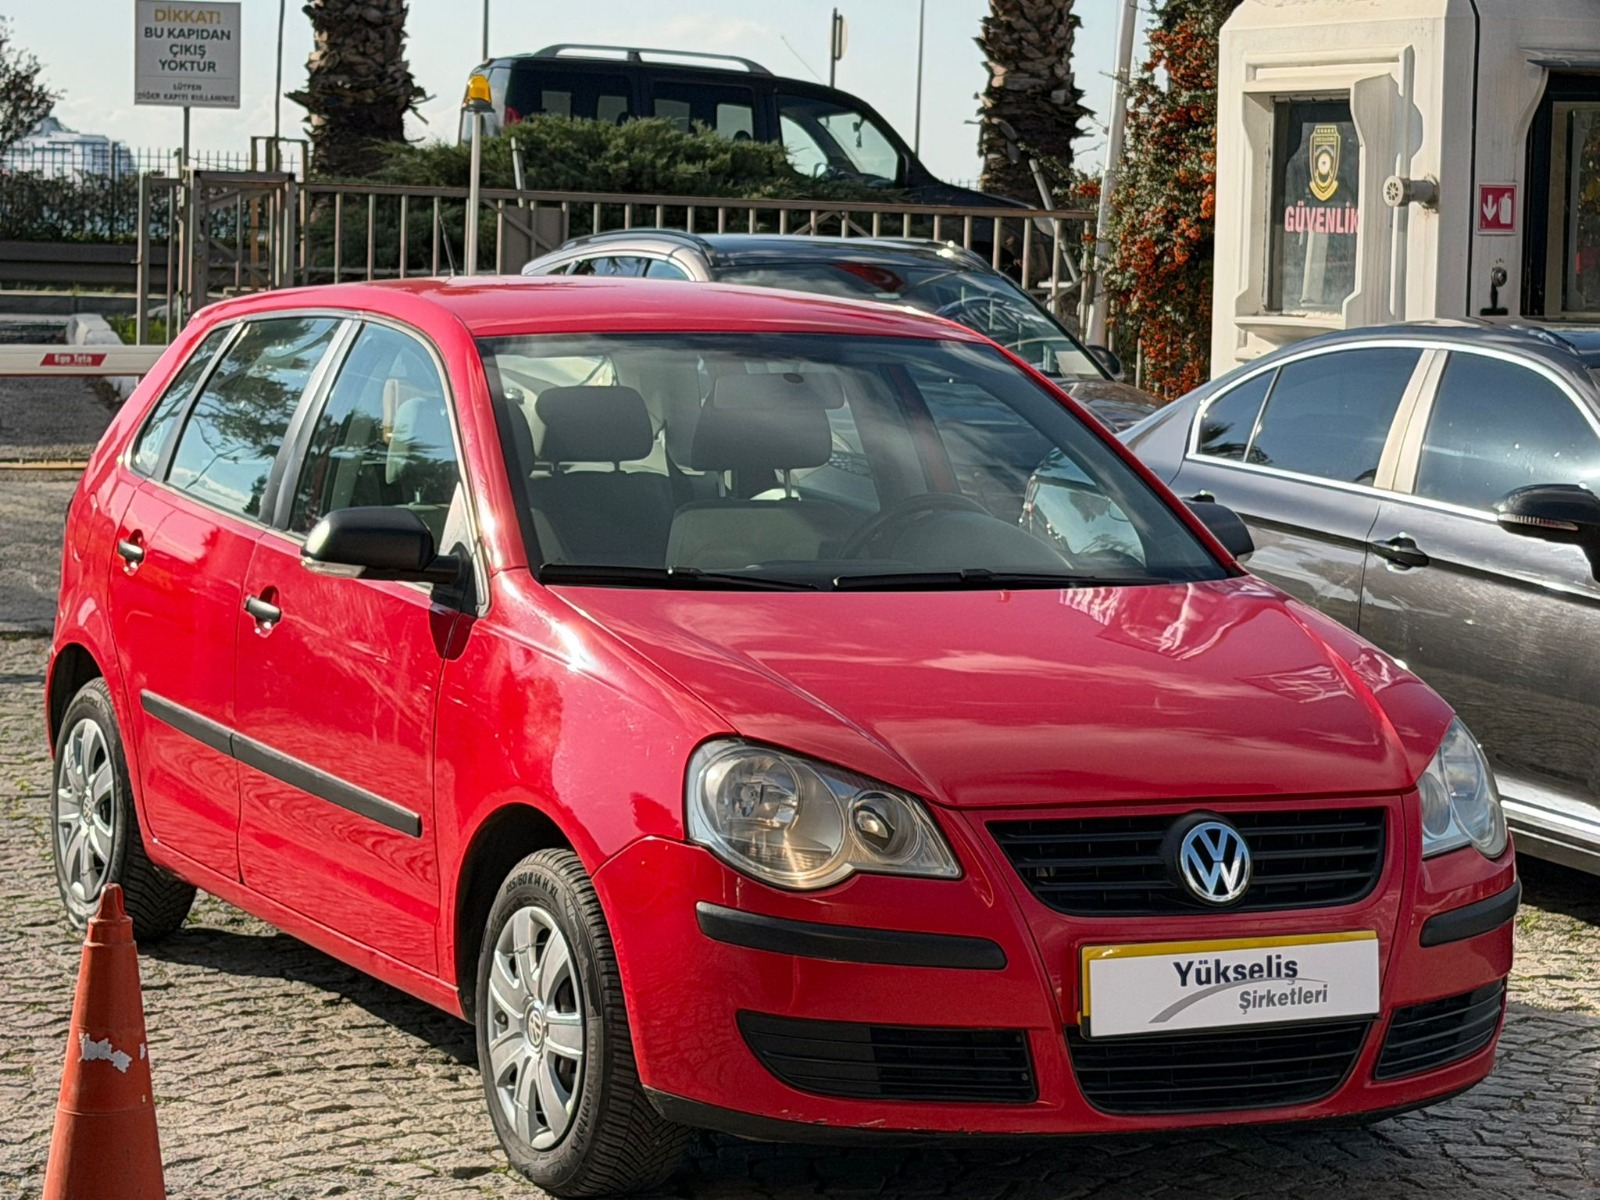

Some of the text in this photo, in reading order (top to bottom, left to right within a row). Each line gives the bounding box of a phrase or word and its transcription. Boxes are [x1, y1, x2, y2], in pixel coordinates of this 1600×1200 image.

[154, 7, 222, 25] DİKKAT!
[144, 26, 231, 41] BU KAPIDAN
[169, 44, 206, 59] ÇIKIŞ
[158, 59, 217, 73] YOKTUR
[173, 82, 202, 91] LÜTFEN
[1173, 954, 1299, 986] Yükseliş
[1238, 984, 1328, 1015] Şirketleri
